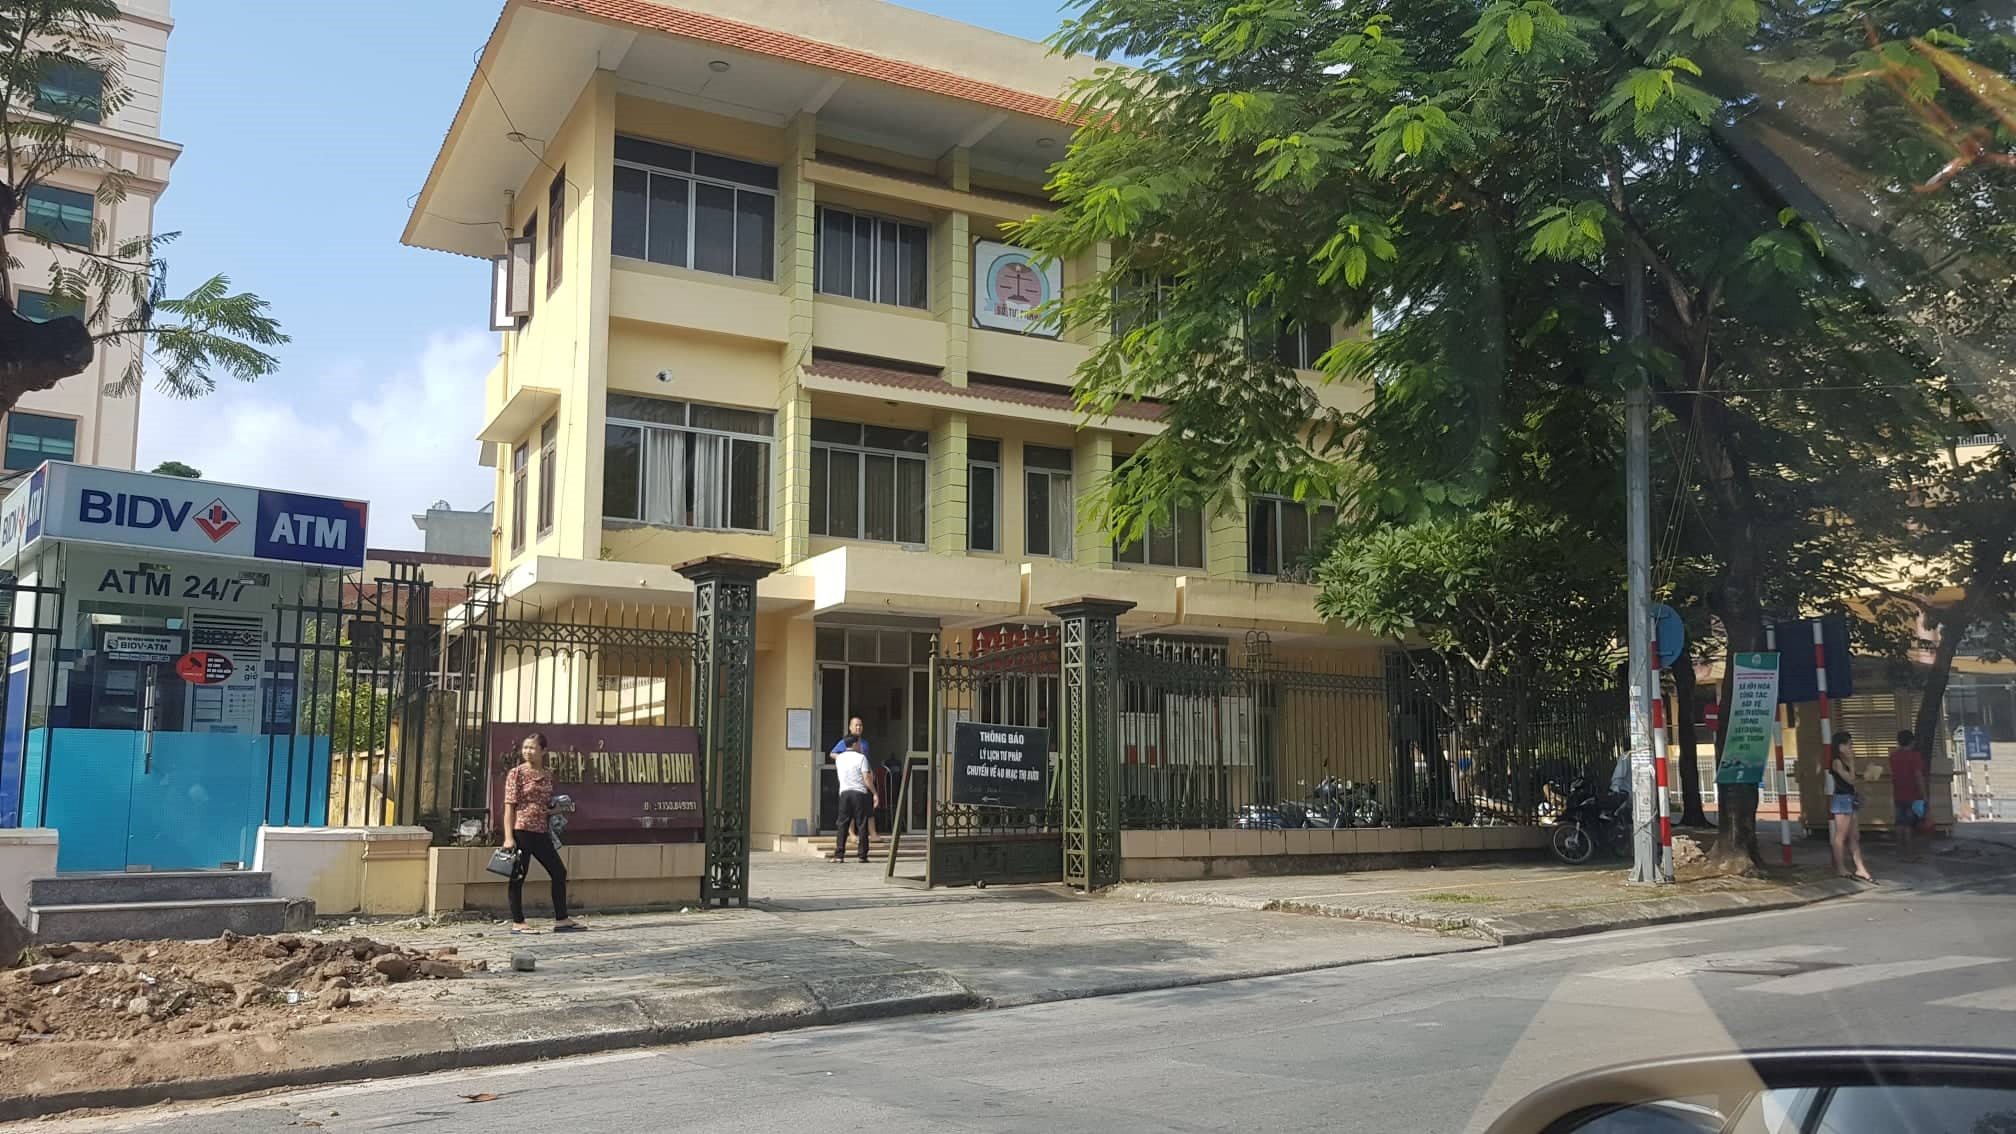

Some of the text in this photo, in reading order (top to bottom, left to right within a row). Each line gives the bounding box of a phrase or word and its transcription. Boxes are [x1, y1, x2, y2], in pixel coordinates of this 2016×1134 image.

[79, 488, 193, 532] BIDV
[269, 512, 347, 550] ATM
[97, 568, 247, 602] ATM 24/7
[979, 730, 1025, 745] THÔNG BÁO
[979, 747, 1023, 762] LÝ LỊCH TƯ PHÁP
[590, 739, 624, 783] TỈNH
[626, 752, 659, 783] NAM
